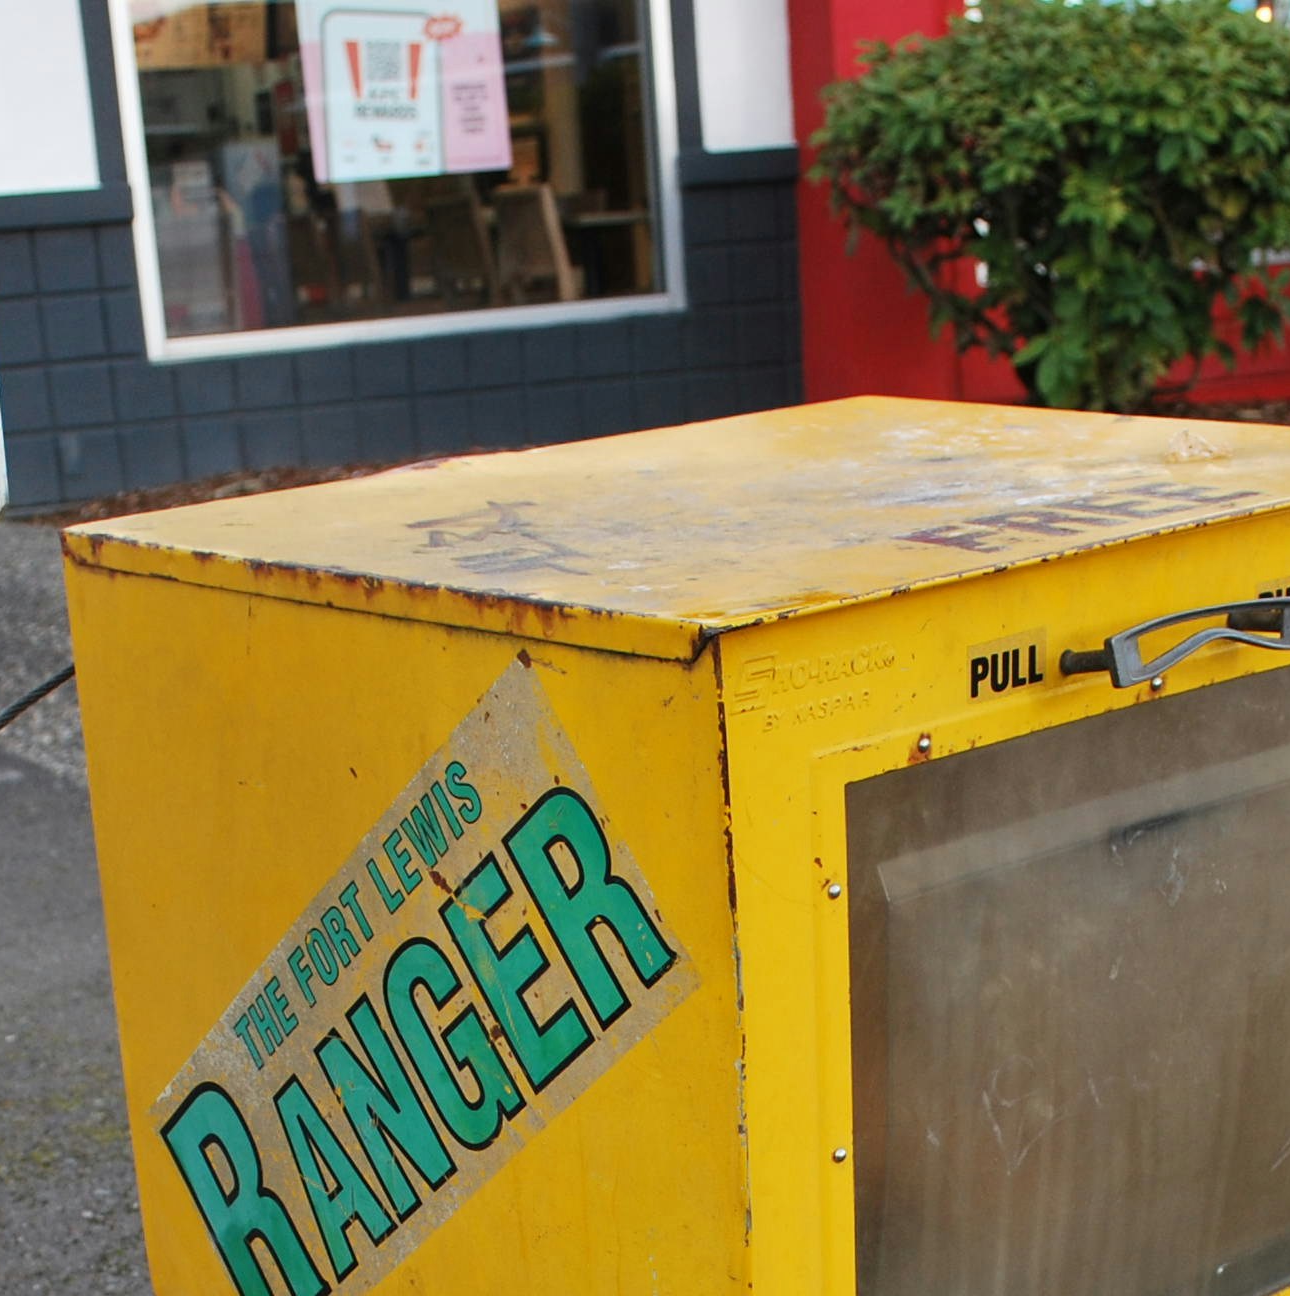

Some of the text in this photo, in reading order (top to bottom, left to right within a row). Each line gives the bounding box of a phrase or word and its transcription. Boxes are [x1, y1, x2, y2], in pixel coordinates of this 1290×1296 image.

[892, 482, 1262, 554] FREE
[971, 644, 1044, 698] PULL
[233, 761, 482, 1070] THE FORT LEWIS
